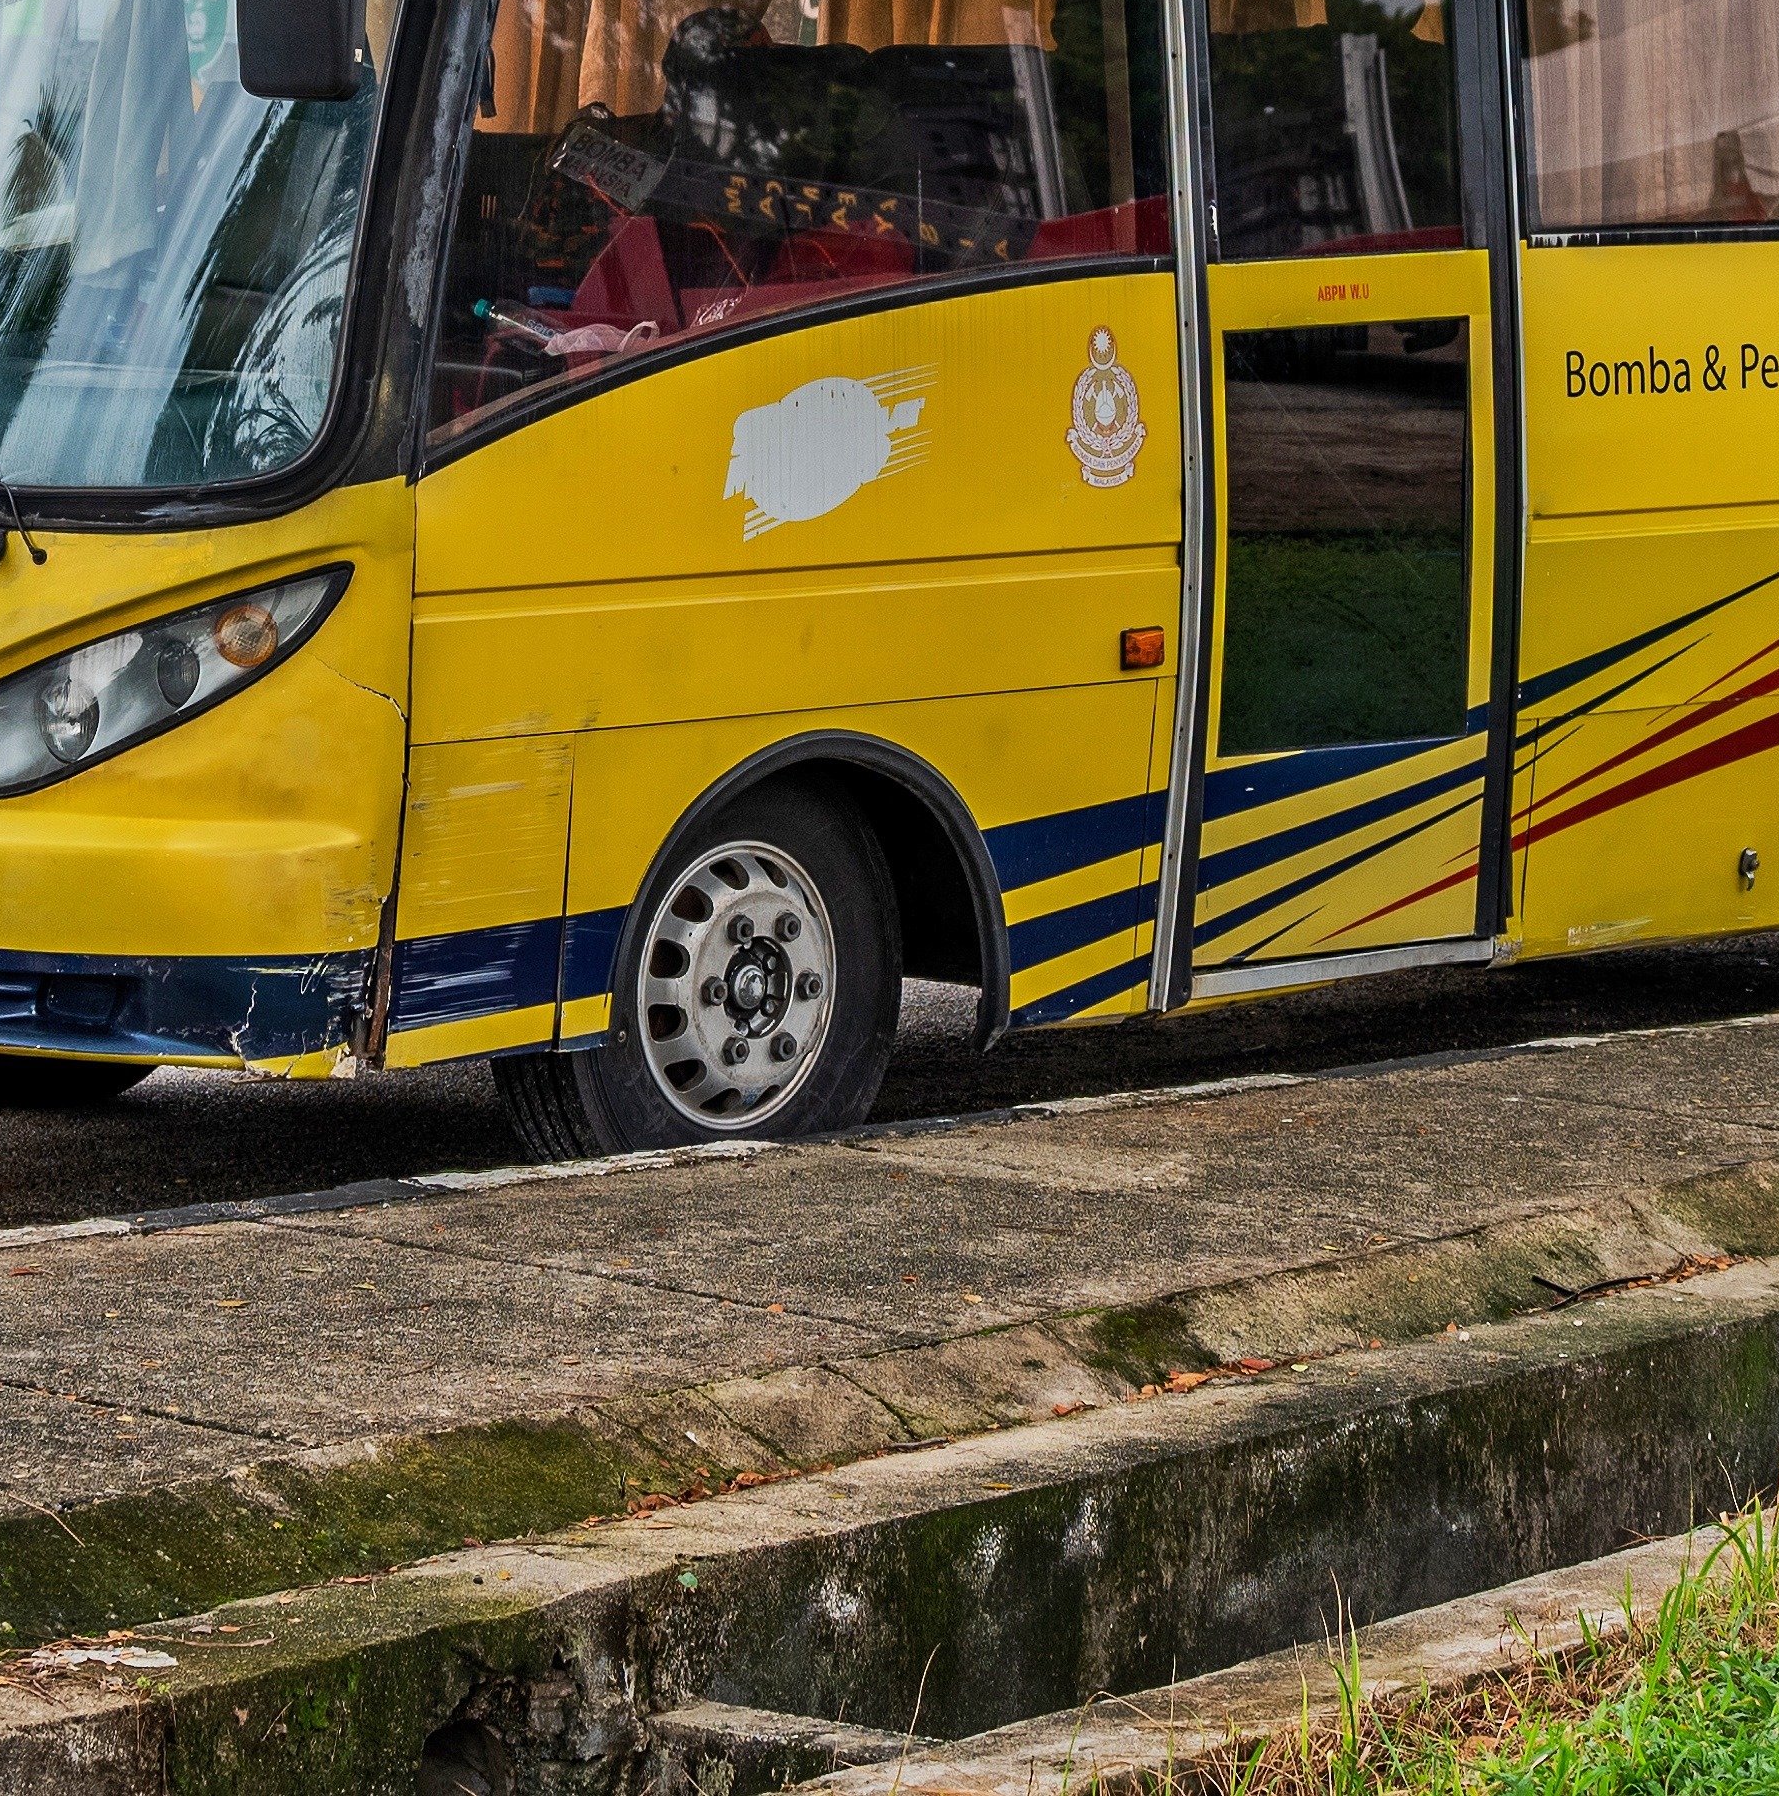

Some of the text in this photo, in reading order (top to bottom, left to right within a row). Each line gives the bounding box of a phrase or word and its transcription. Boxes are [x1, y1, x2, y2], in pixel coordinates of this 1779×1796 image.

[1317, 285, 1347, 302] ABPM
[1565, 346, 1691, 398] Bomba
[1702, 344, 1728, 392] &
